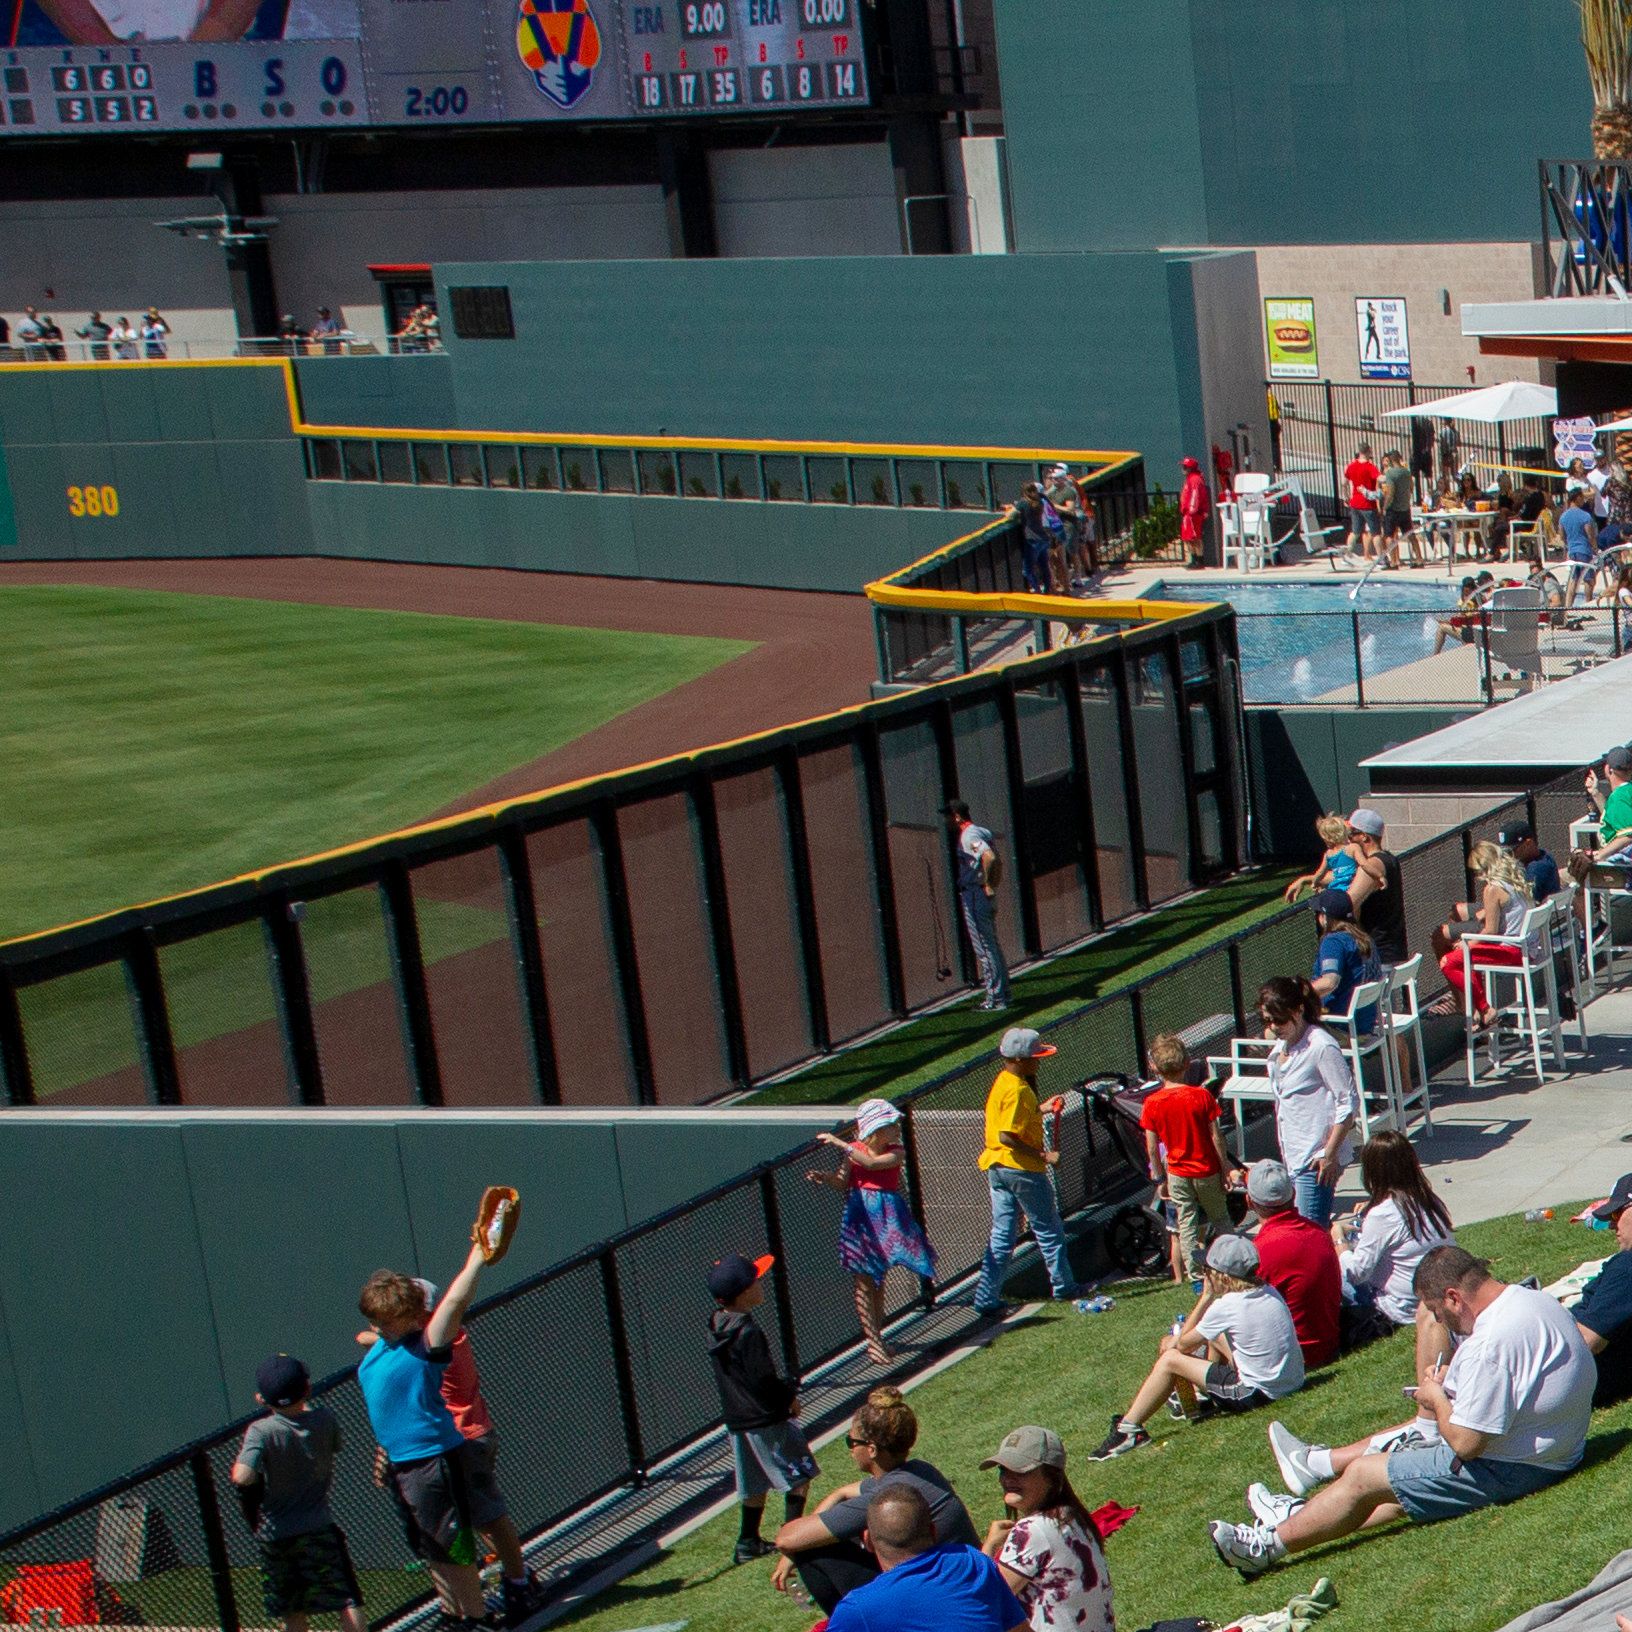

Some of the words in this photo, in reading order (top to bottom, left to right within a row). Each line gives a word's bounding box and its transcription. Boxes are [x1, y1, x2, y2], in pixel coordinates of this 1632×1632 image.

[635, 7, 664, 34] ERA
[687, 3, 725, 33] 9.00
[65, 69, 78, 89] 6
[102, 69, 115, 89] 6
[133, 67, 147, 88] 0
[194, 60, 216, 98] B
[264, 58, 285, 96] S
[642, 77, 660, 105] 18
[680, 75, 696, 104] 17
[715, 72, 734, 102] 35
[763, 69, 773, 99] 6
[800, 66, 811, 98] 8
[836, 64, 854, 96] 14
[70, 101, 84, 120] 5
[107, 101, 120, 120] 5
[140, 100, 153, 120] 2
[405, 86, 468, 116] 2:00
[1381, 302, 1398, 312] Knock
[1382, 315, 1395, 323] your
[68, 485, 119, 517] 380
